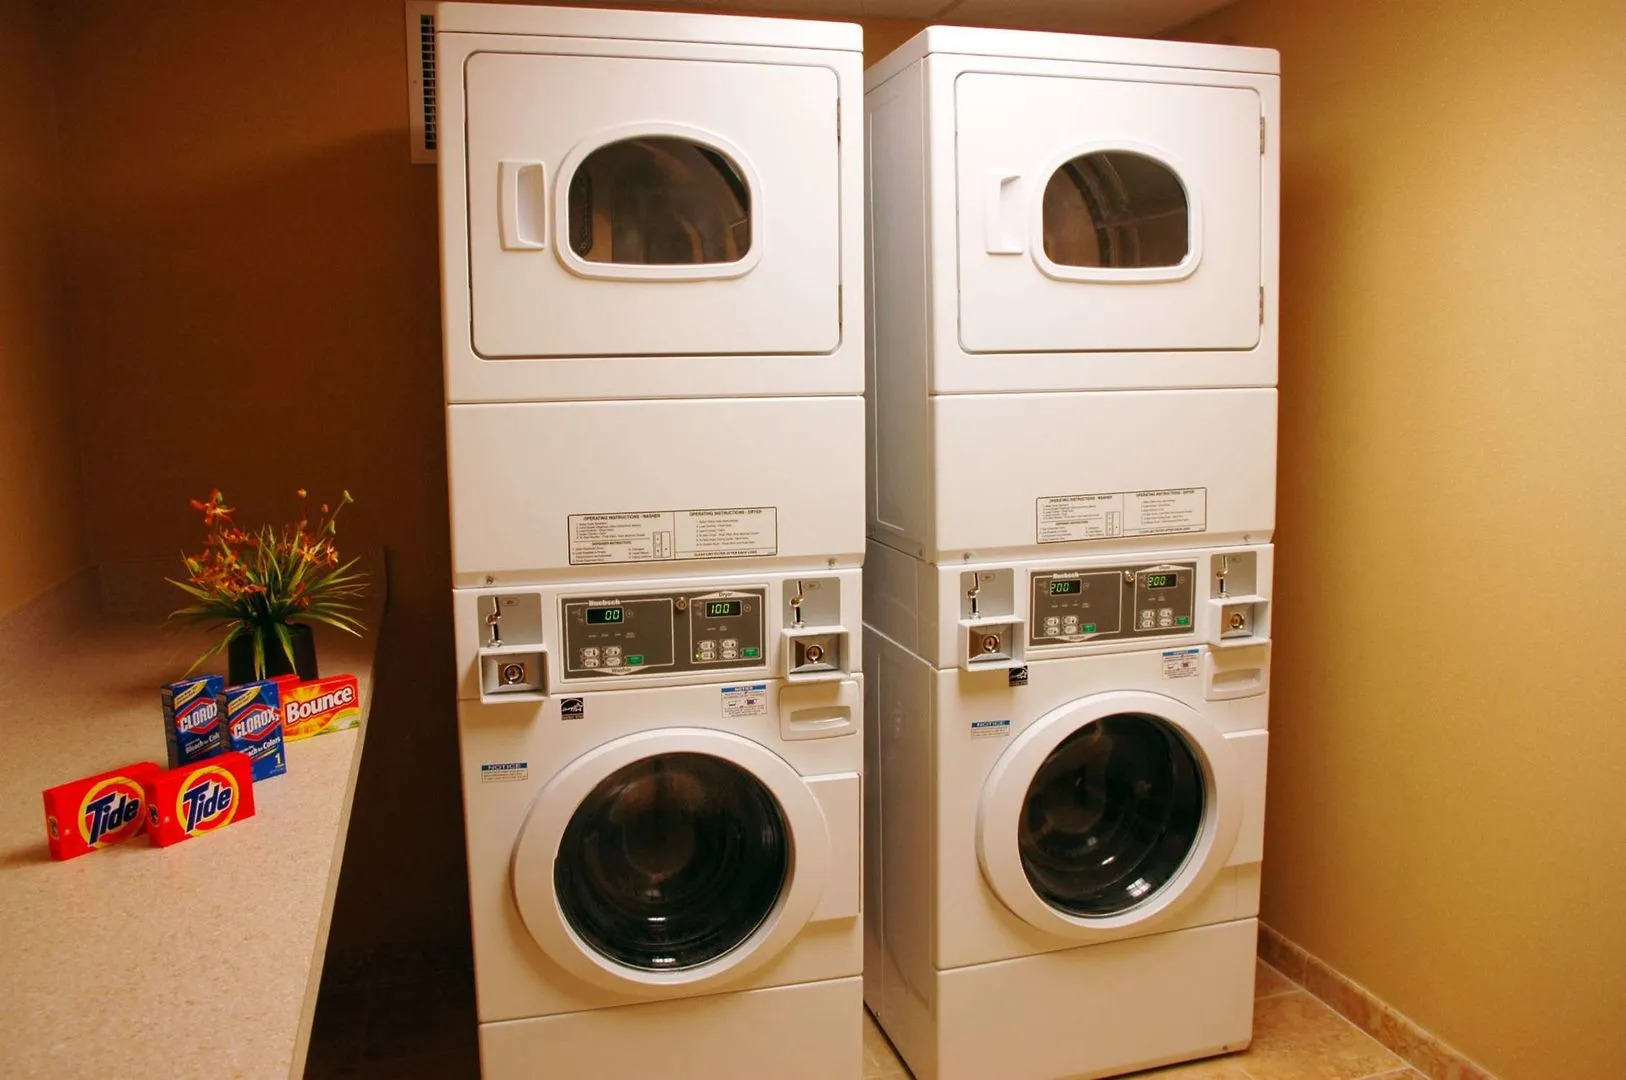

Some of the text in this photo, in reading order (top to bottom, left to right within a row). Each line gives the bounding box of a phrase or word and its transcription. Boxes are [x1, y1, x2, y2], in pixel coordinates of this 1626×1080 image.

[604, 610, 620, 621] 00
[711, 603, 730, 614] 100
[286, 687, 353, 724] Bounce
[263, 736, 281, 749] Colors
[182, 779, 233, 834] Tide
[85, 791, 141, 848] Tide
